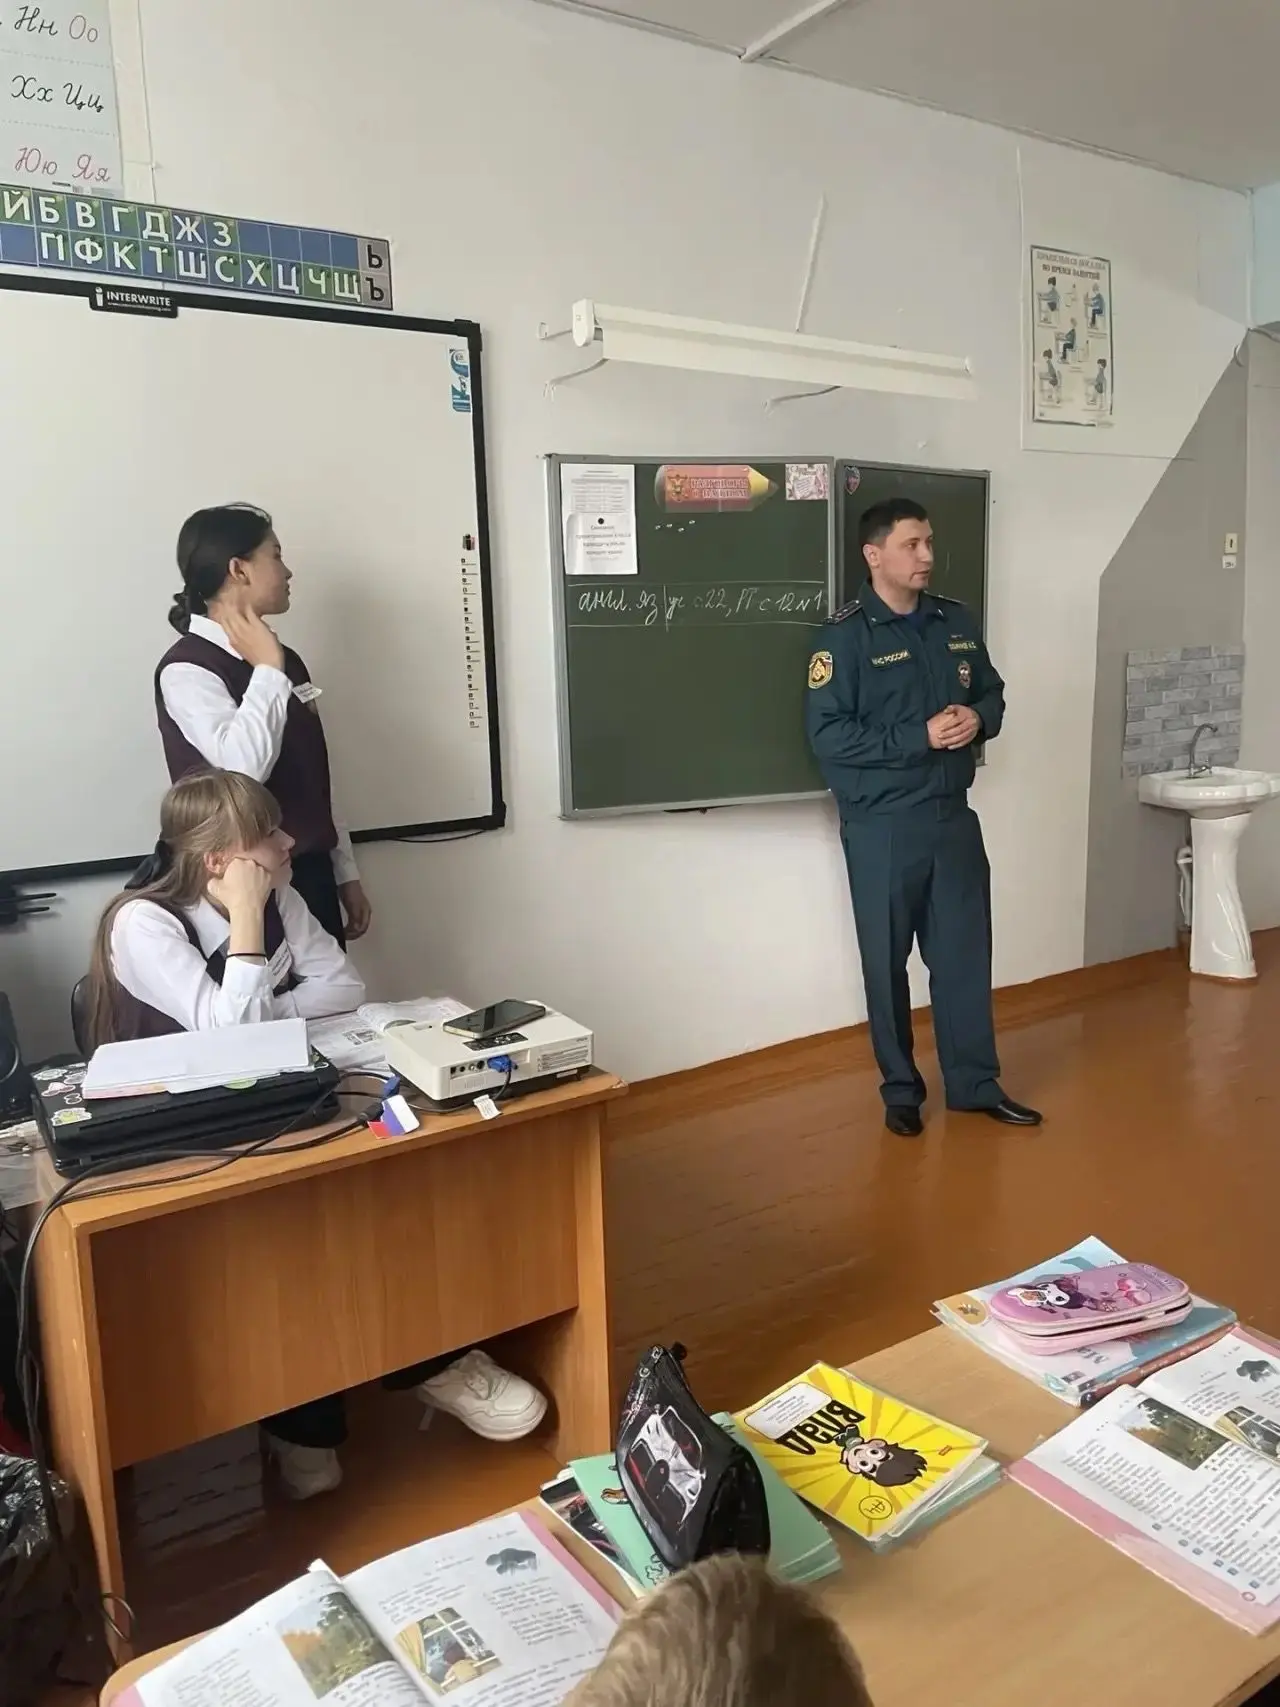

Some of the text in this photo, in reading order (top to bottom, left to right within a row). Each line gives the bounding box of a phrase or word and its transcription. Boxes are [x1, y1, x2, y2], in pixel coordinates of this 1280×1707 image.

[14, 6, 99, 43] Нн Оо
[11, 75, 104, 113] Хх Цц
[15, 147, 111, 183] Юю Яя
[3, 190, 30, 221] Й
[39, 197, 60, 224] Б
[75, 201, 96, 228] В
[112, 206, 130, 232] Г
[142, 211, 169, 242] Д
[174, 215, 205, 245] Ж
[213, 221, 232, 247] З
[40, 232, 65, 261] П
[74, 237, 103, 265] Ф
[113, 241, 136, 270] К
[149, 246, 168, 273] Т
[178, 250, 207, 280] Ш
[215, 256, 234, 283] С
[247, 259, 267, 287] Х
[277, 263, 300, 294] Ц
[308, 268, 326, 294] Ч
[334, 272, 361, 303] Щ
[106, 290, 171, 307] INTERWRITE
